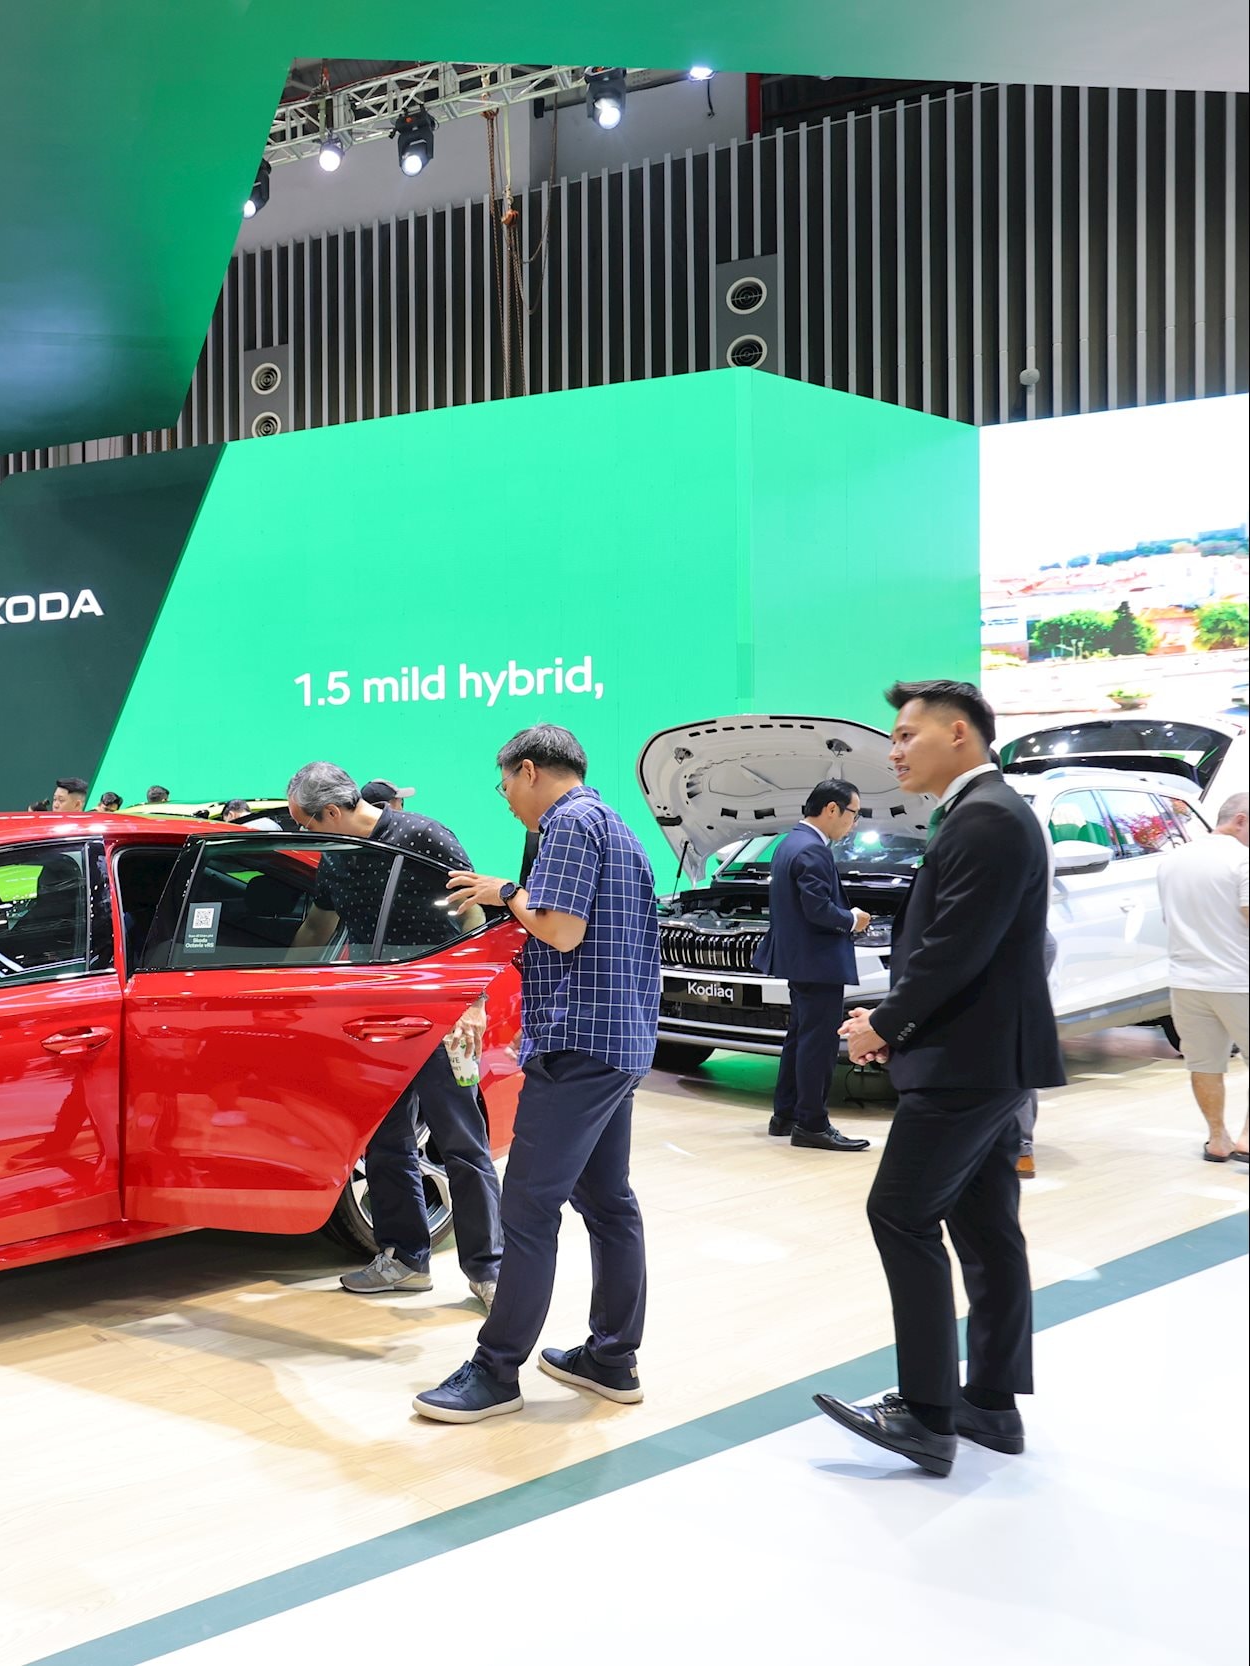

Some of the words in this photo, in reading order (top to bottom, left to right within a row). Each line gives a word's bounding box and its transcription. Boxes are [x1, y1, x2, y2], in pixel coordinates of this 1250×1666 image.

[294, 670, 351, 706] 1.5
[363, 664, 446, 703] mild
[459, 655, 604, 707] hybrid,
[687, 981, 734, 1002] Kodiaq
